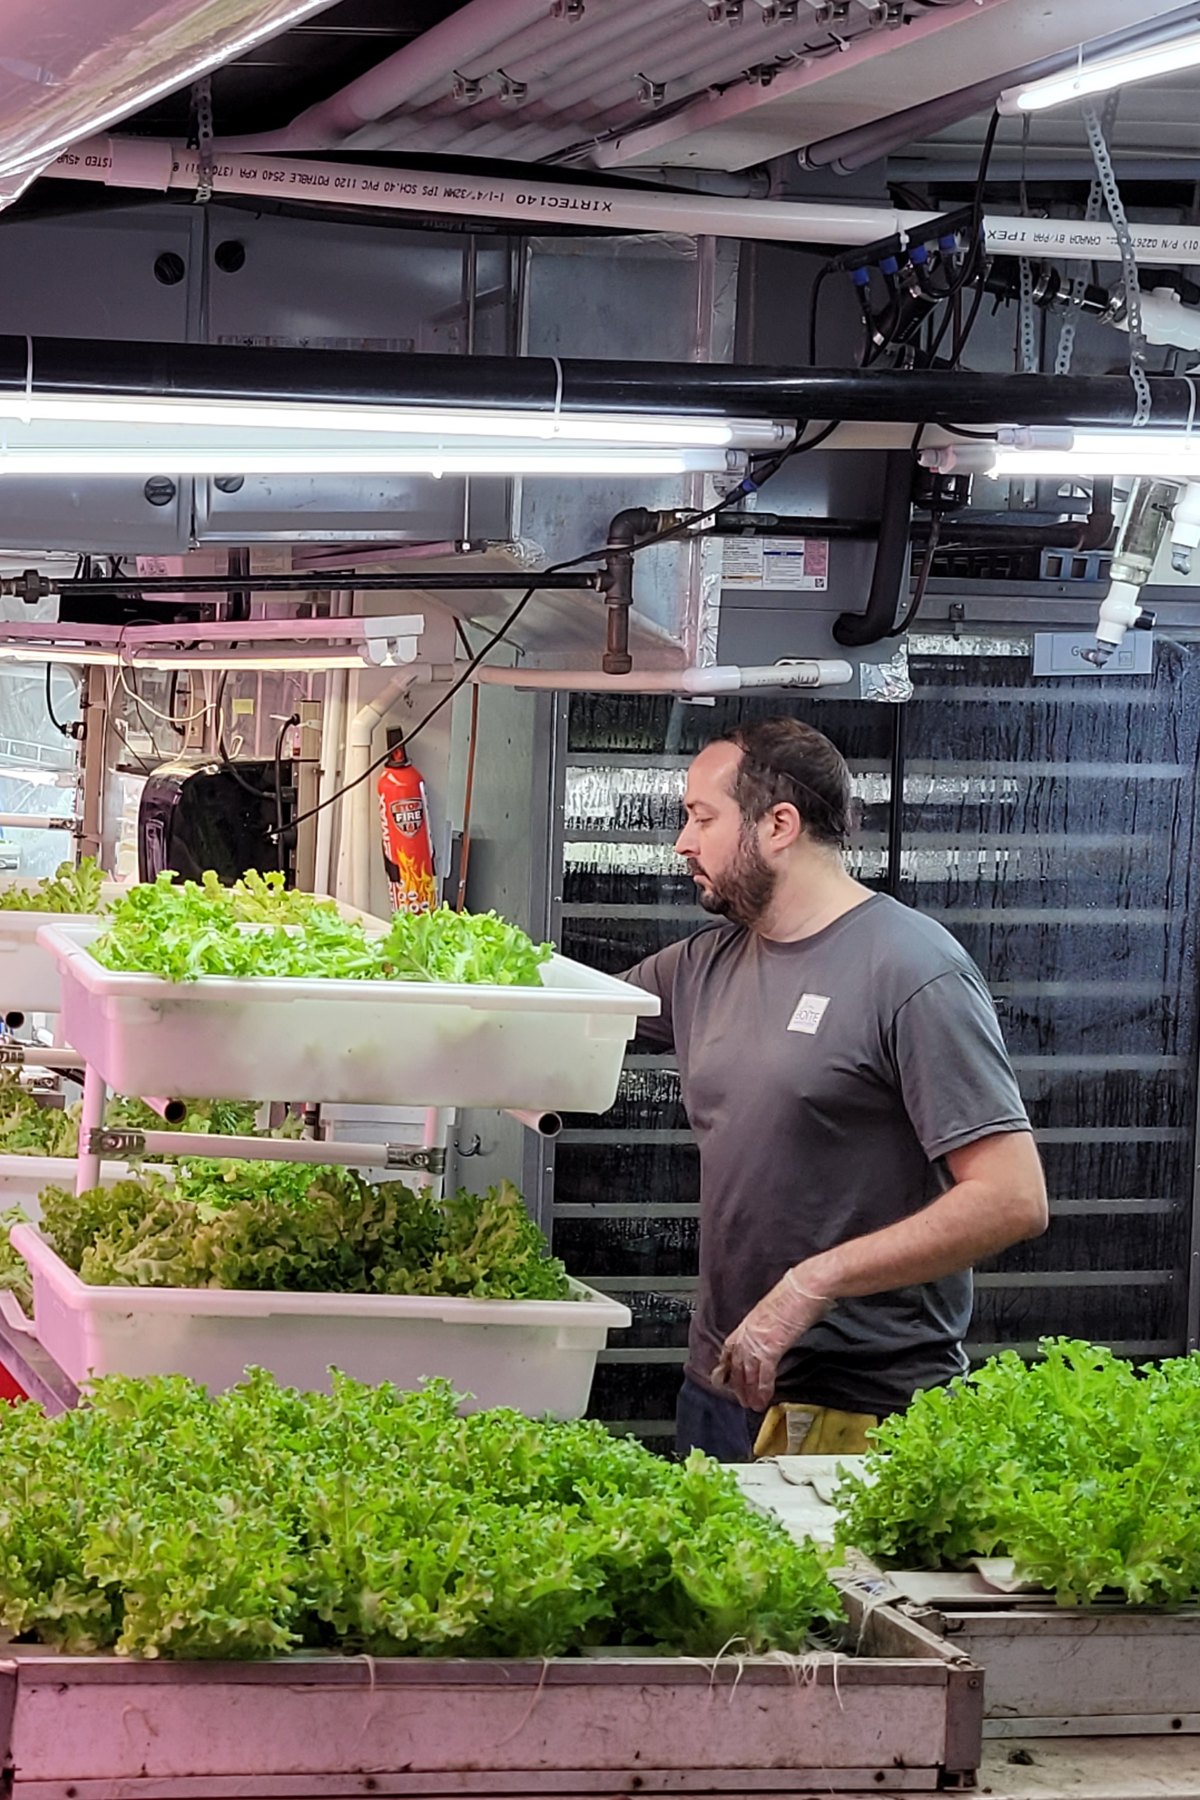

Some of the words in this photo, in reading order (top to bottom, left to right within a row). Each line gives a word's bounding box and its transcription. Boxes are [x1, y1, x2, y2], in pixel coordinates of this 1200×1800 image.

[84, 156, 112, 168] ISTED
[239, 168, 257, 179] KPA
[262, 170, 285, 182] 2540
[290, 172, 330, 186] POTABLE
[334, 178, 356, 188] 1120
[362, 180, 380, 190] PVC
[384, 182, 418, 194] SCH.40
[422, 186, 438, 196] IPS
[516, 194, 612, 212] XIRTEC140
[987, 230, 1027, 242] IPEX
[1070, 235, 1101, 246] CANADA
[1130, 238, 1158, 249] 02267
[1161, 239, 1178, 250] P/N
[395, 810, 422, 823] FIRE
